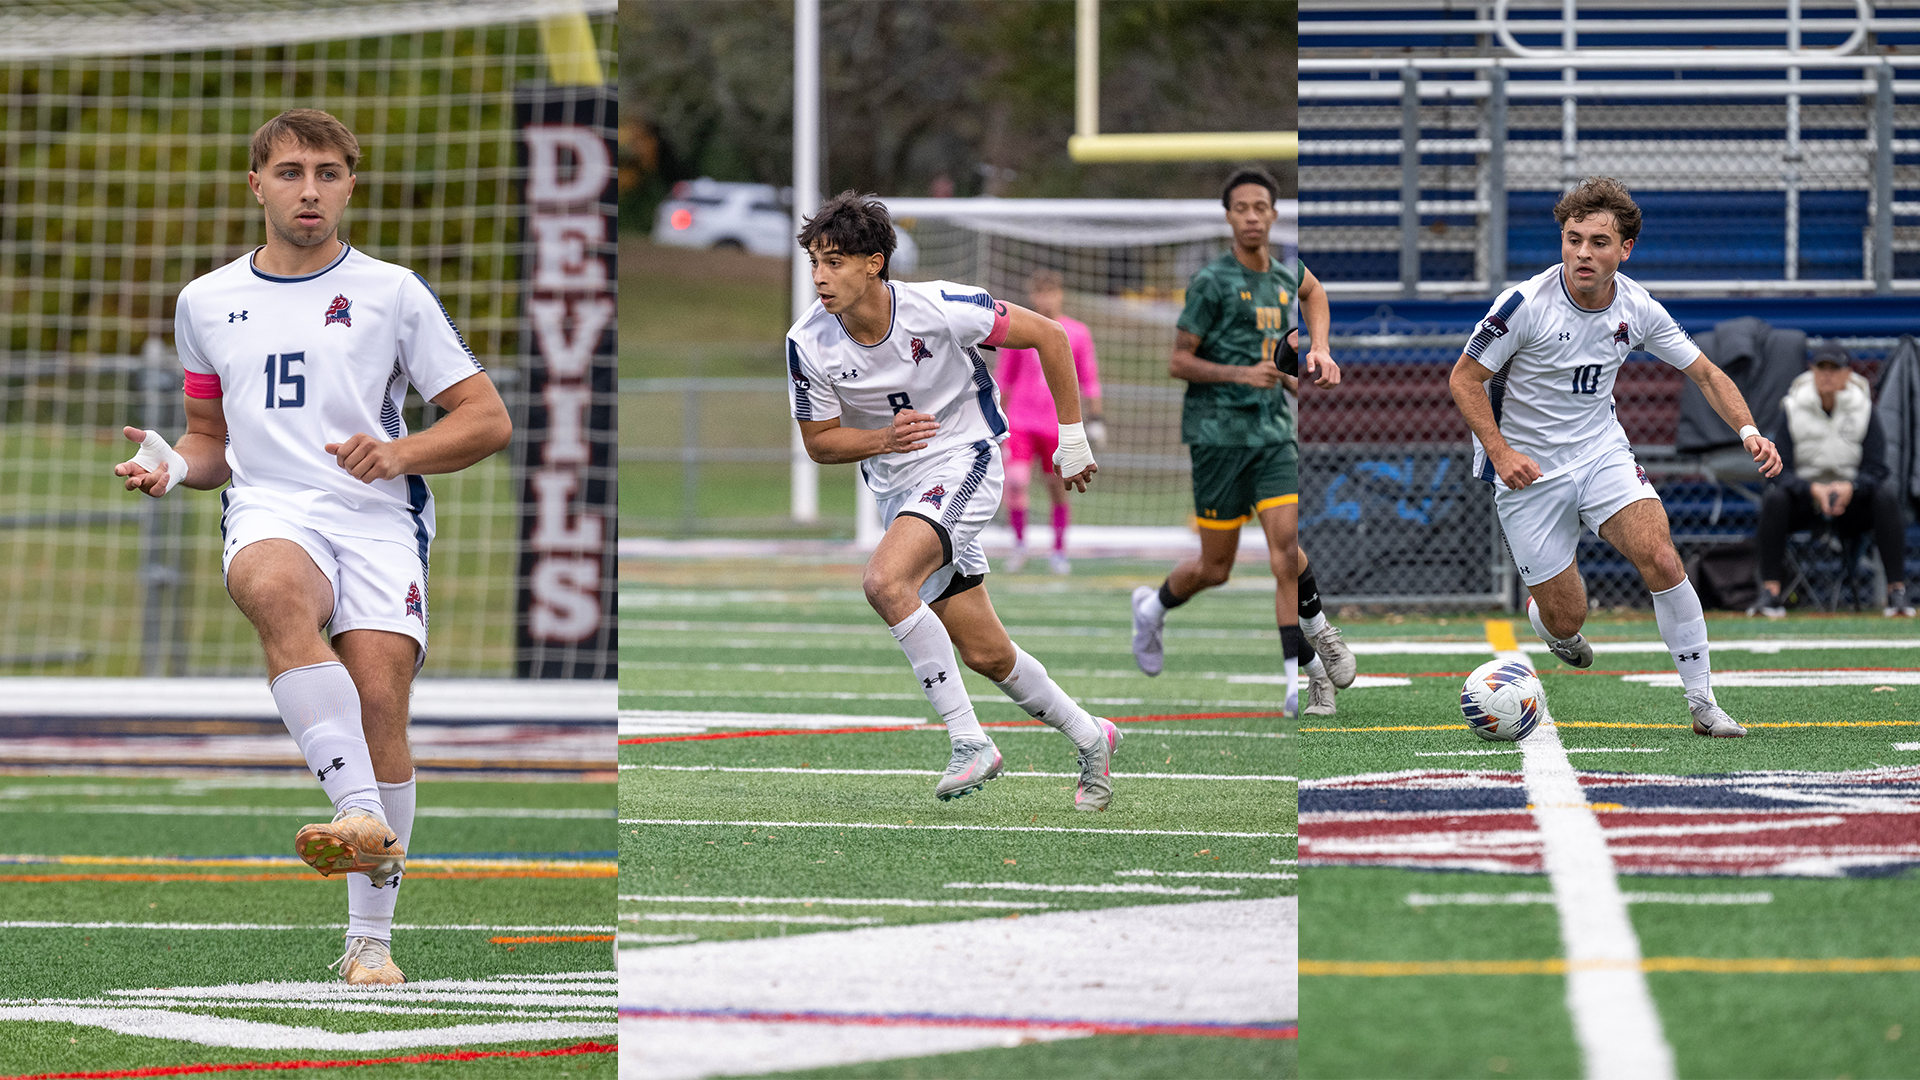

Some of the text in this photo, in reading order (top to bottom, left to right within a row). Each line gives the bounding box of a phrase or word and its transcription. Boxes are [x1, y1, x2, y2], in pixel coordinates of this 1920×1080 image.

[1482, 320, 1504, 337] MAC
[263, 351, 305, 409] 15
[526, 124, 612, 641] DEVILS
[1572, 364, 1603, 395] 10
